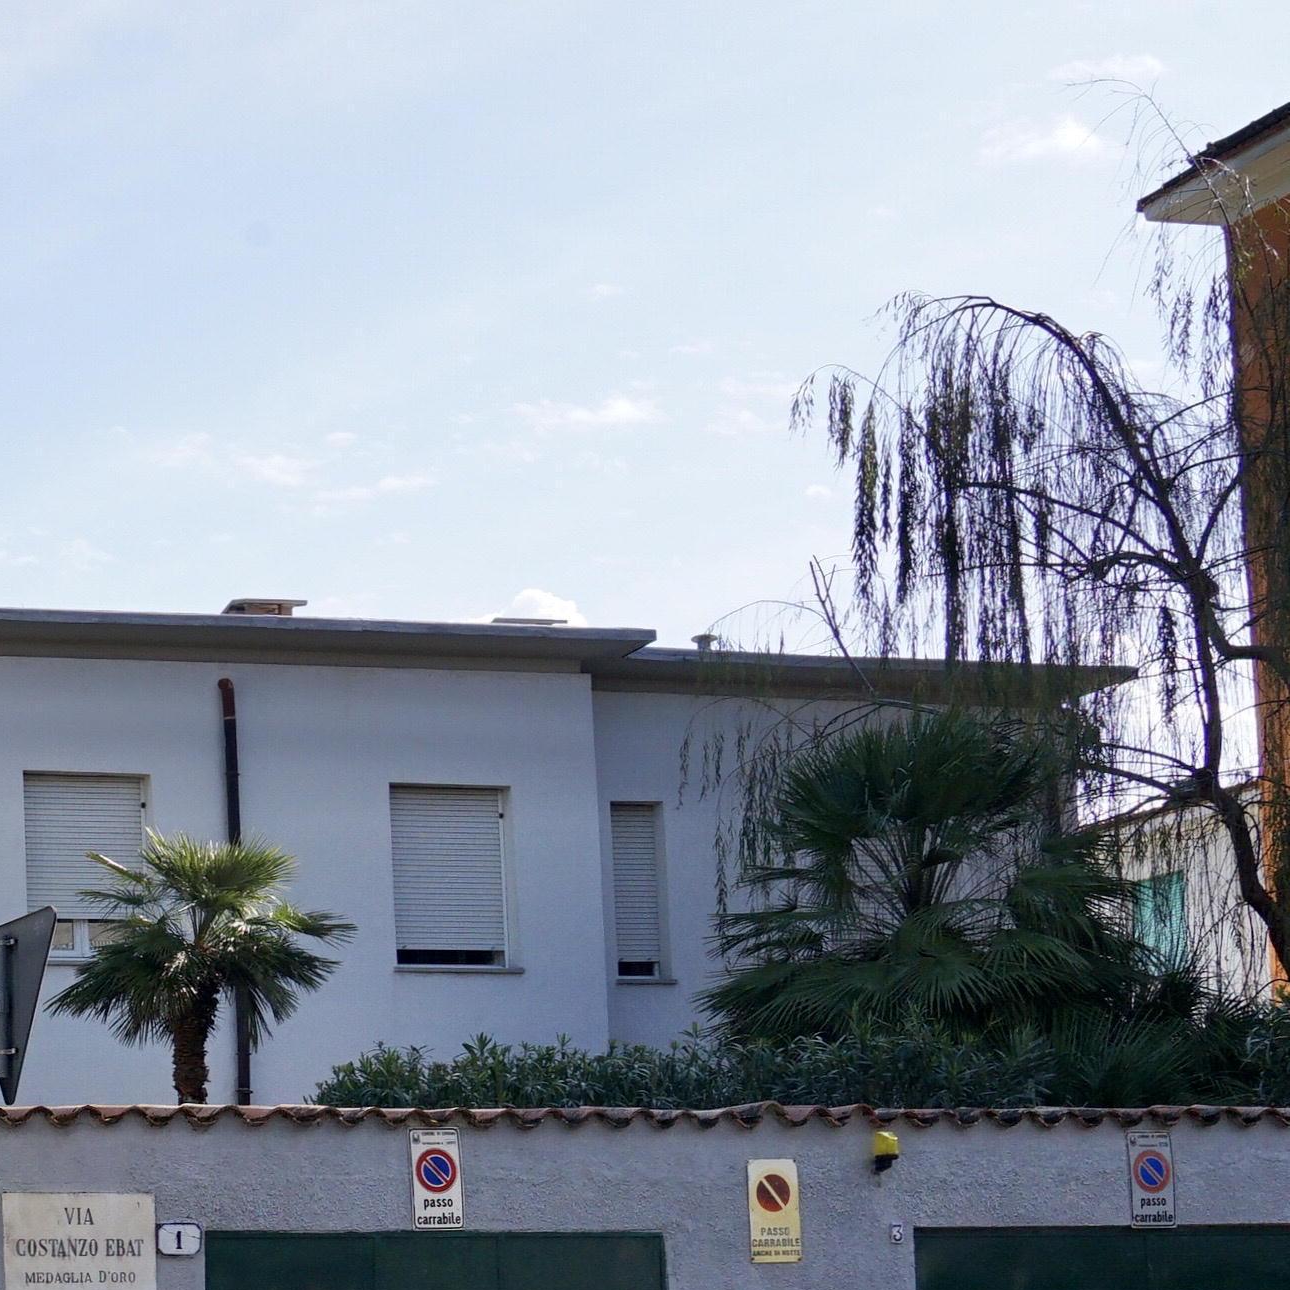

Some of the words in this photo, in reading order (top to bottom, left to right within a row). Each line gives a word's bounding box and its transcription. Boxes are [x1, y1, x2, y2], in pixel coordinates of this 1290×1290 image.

[424, 1198, 453, 1210] passo
[1140, 1197, 1167, 1209] passo
[64, 1207, 95, 1226] VIA
[417, 1212, 461, 1225] carrabile
[1134, 1211, 1174, 1223] carrabile
[760, 1227, 790, 1236] PASSO
[175, 1230, 183, 1250] 1
[752, 1238, 800, 1248] CARRABILE
[15, 1238, 99, 1258] COSTANZO
[106, 1238, 144, 1257] EBAT
[25, 1271, 93, 1284] MEDAGLIA
[99, 1270, 136, 1284] D'ORO
